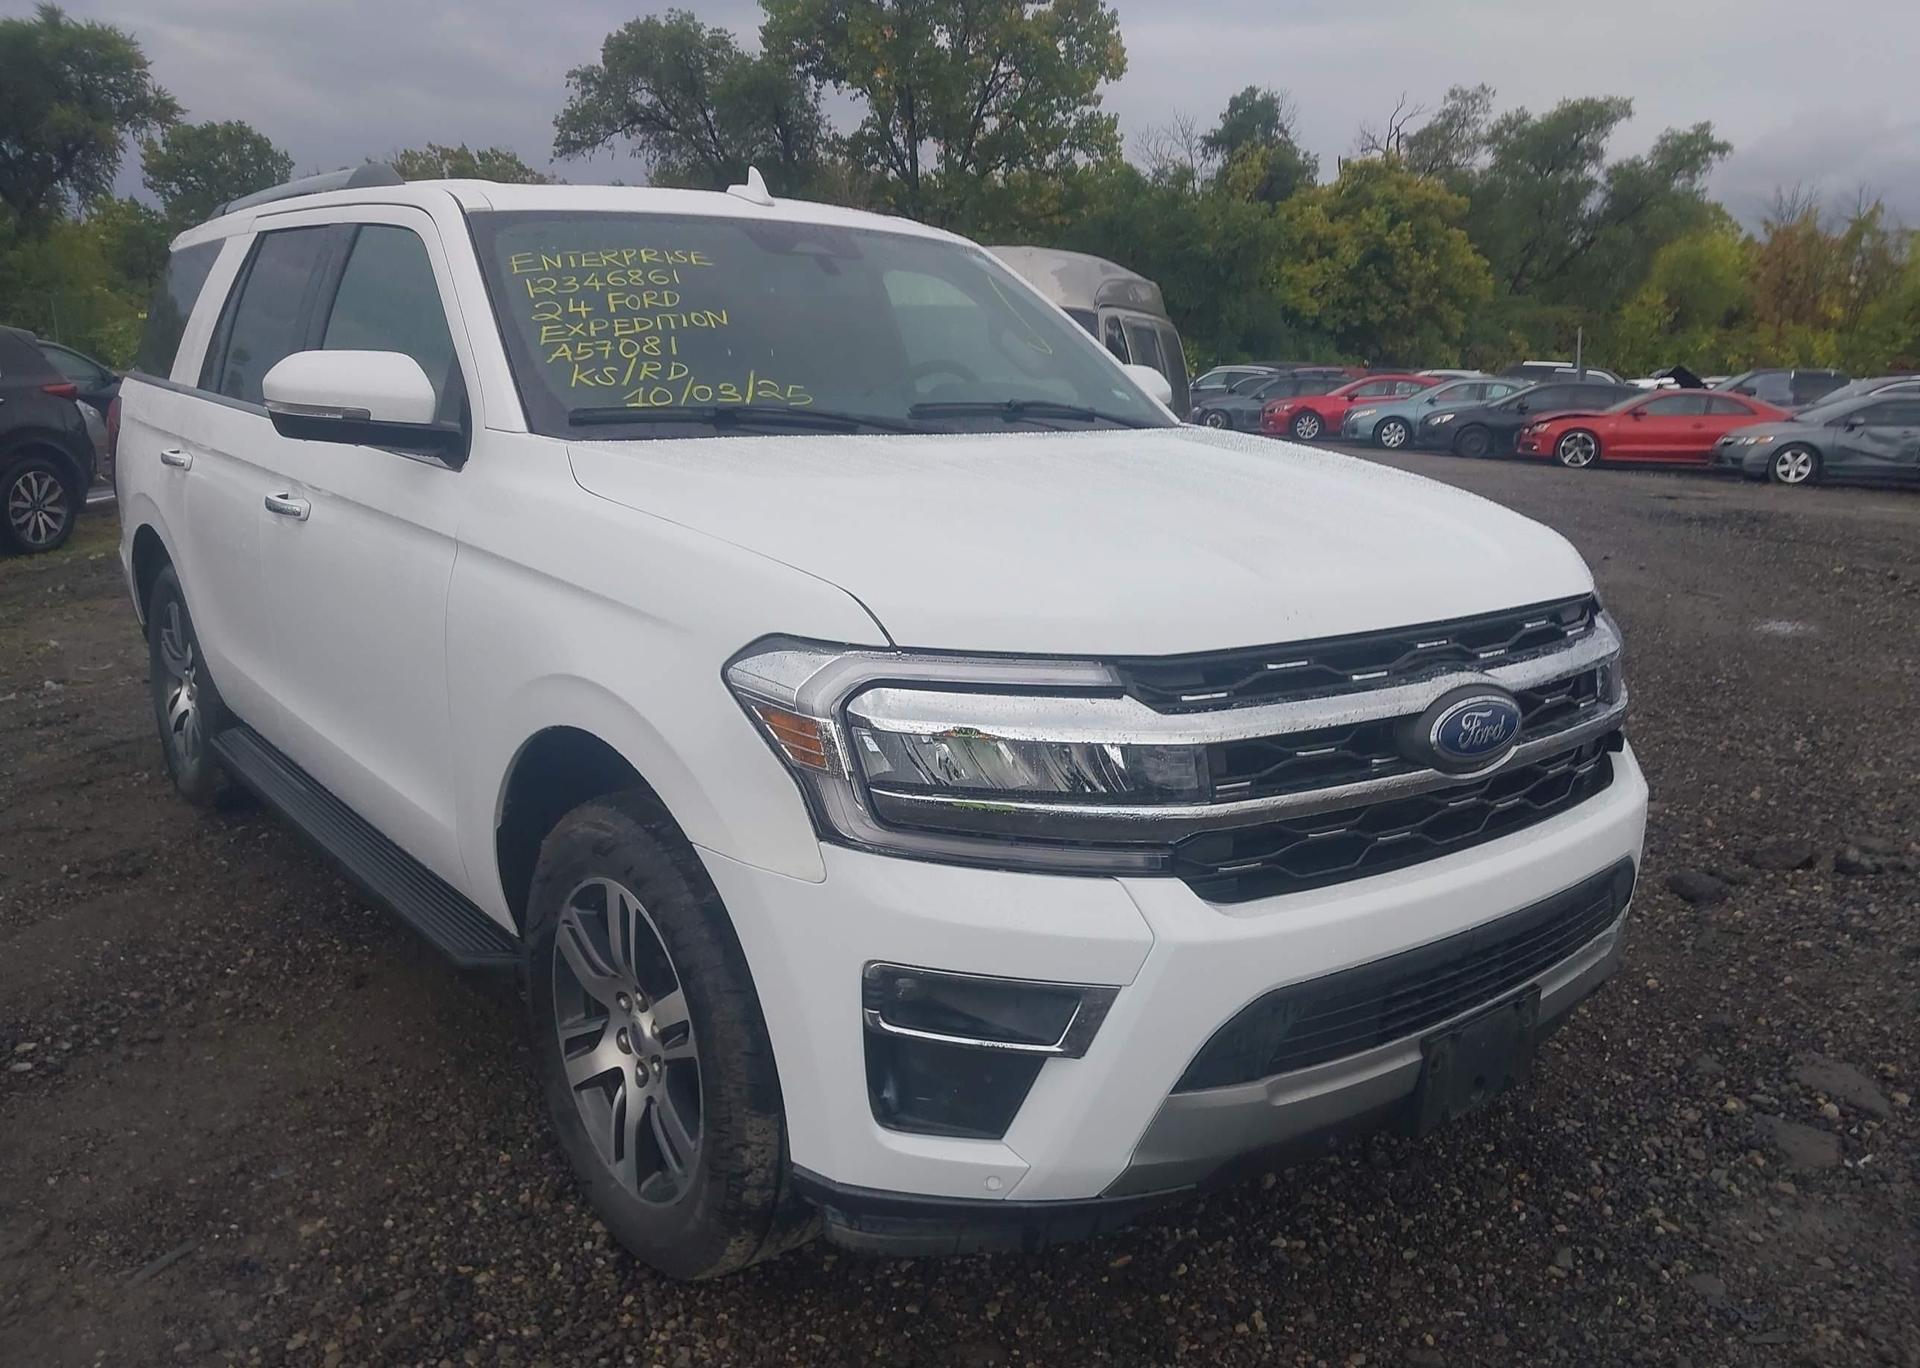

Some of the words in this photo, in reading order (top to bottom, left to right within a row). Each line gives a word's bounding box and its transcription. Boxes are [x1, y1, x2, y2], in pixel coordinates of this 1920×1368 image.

[510, 248, 714, 274] ENTERPRISE
[525, 269, 680, 298] 12346861
[531, 298, 593, 321] 24
[607, 290, 680, 313] FORD
[540, 309, 728, 345] EXPEDITION
[546, 335, 677, 363] A57081
[571, 357, 689, 388] KS/RD
[622, 370, 813, 407] 10/03/25
[1458, 709, 1506, 749] Ford
